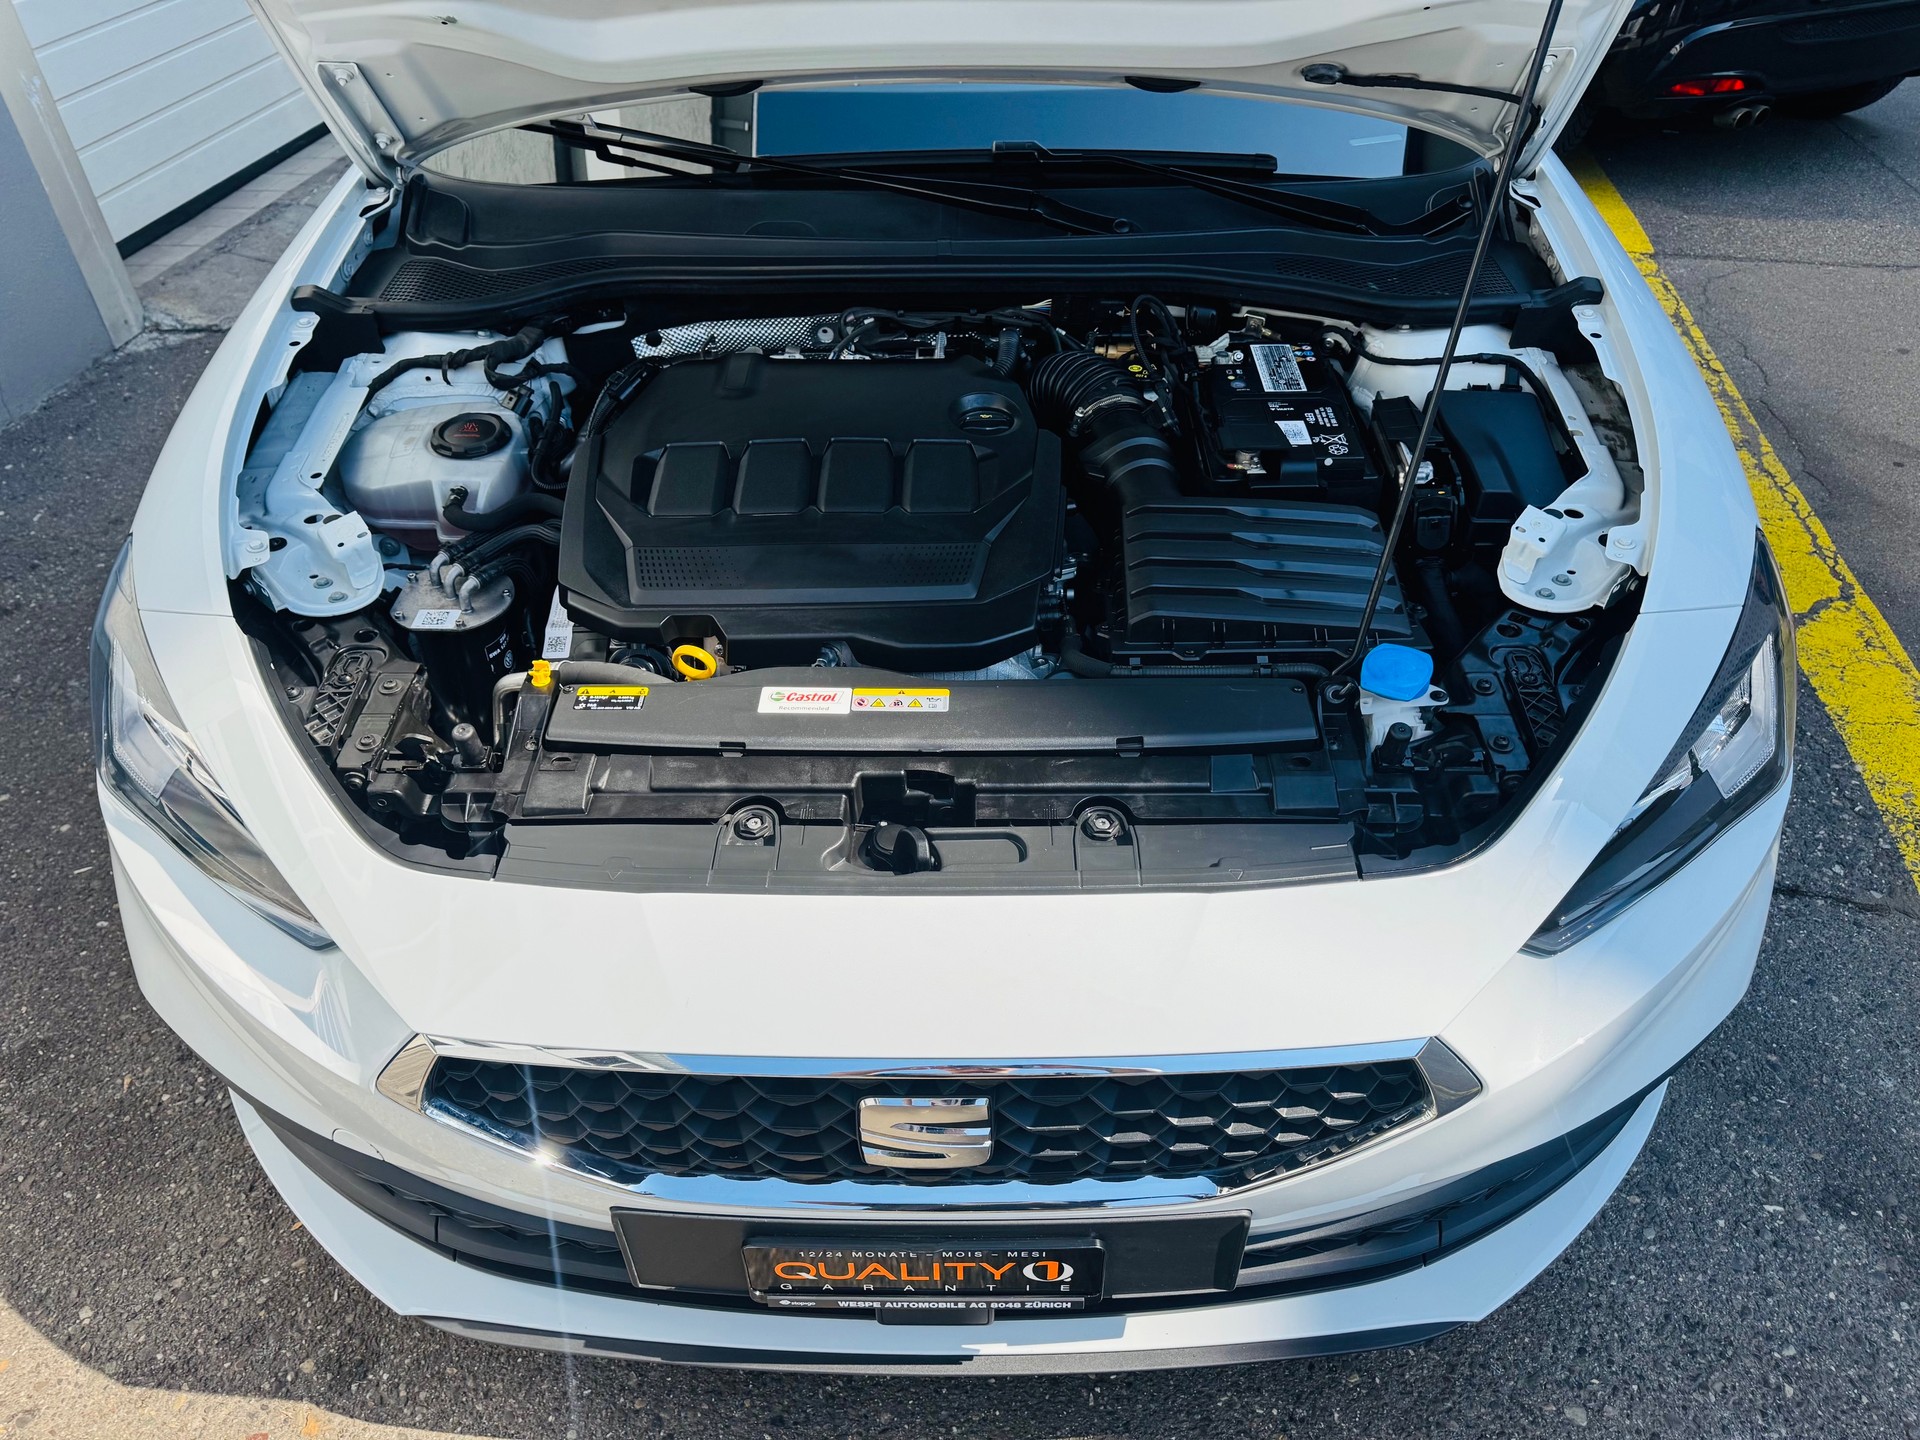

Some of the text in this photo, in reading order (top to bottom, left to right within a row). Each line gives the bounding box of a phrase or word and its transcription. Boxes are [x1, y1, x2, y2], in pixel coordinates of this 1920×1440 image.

[786, 692, 838, 702] Castrol
[774, 1262, 1016, 1280] QUALITY
[1024, 1300, 1072, 1308] ZÜRICH
